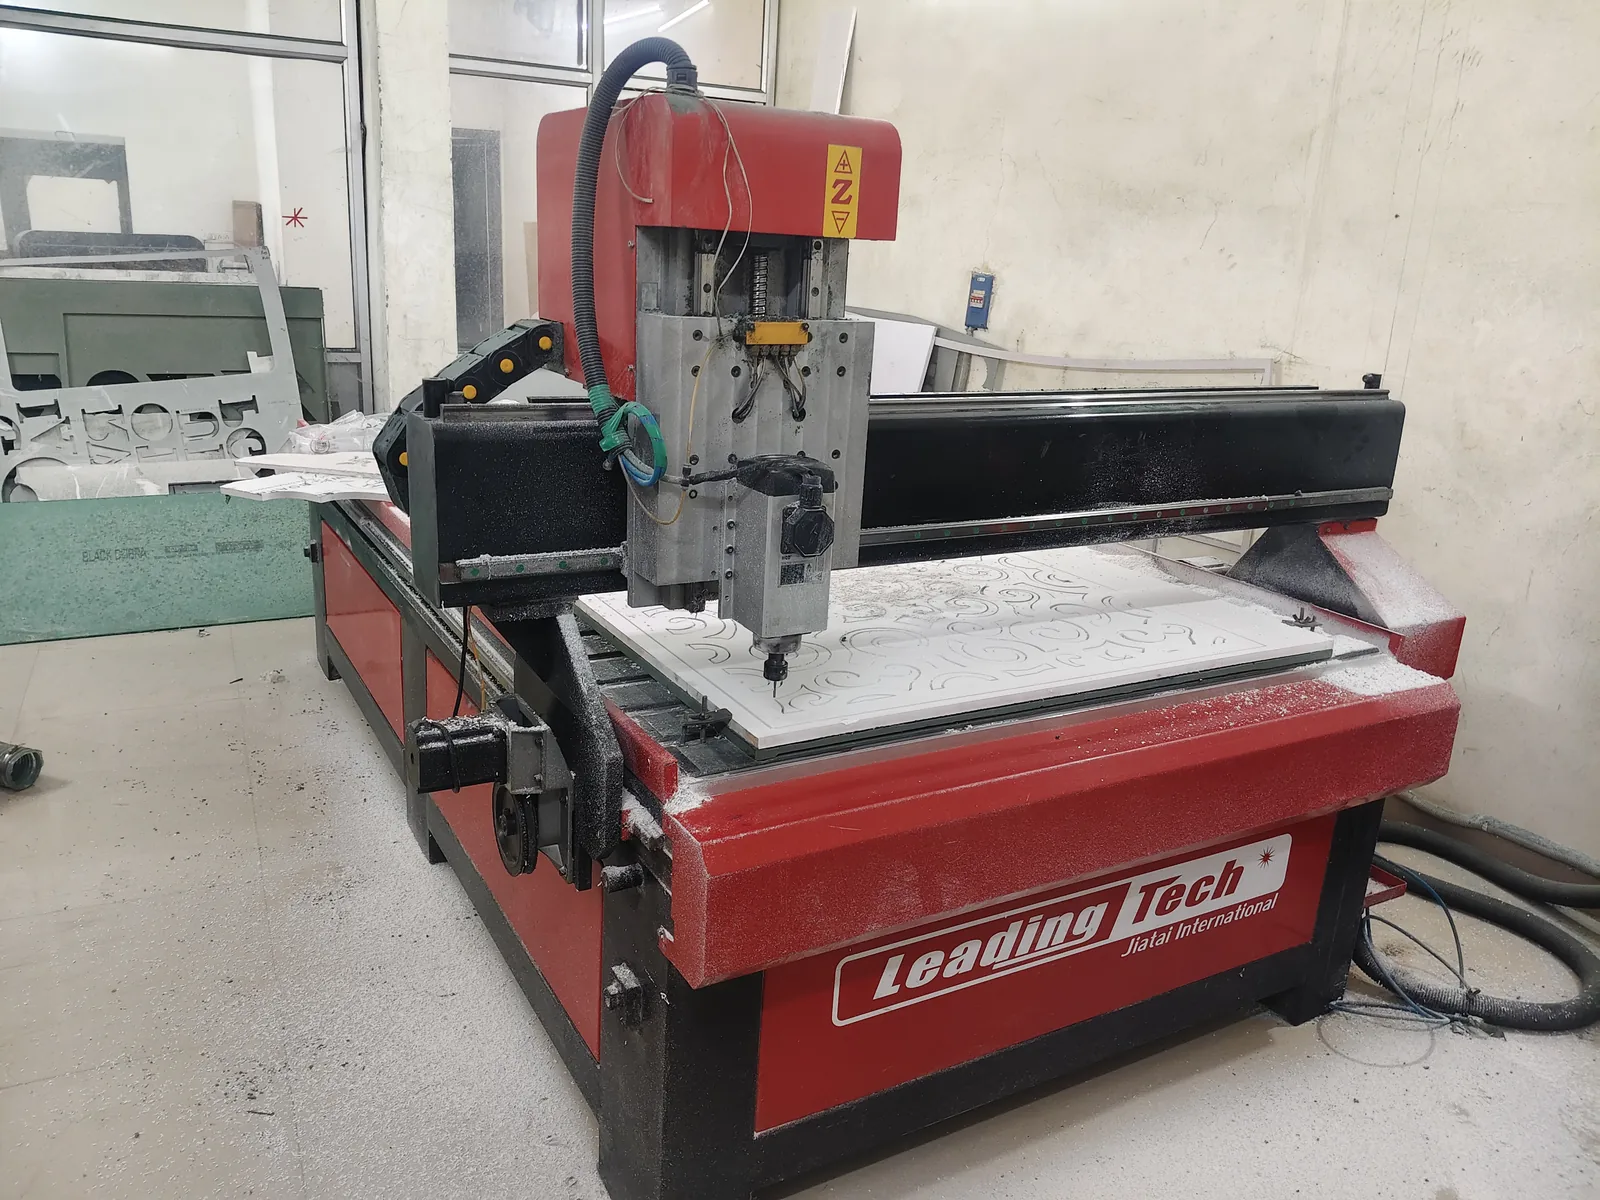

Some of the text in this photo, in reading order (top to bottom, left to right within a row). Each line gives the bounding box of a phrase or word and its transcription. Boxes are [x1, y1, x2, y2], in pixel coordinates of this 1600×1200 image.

[831, 179, 853, 205] Z
[872, 859, 1245, 1000] Leading Tech
[1121, 892, 1279, 957] Jiatai International
